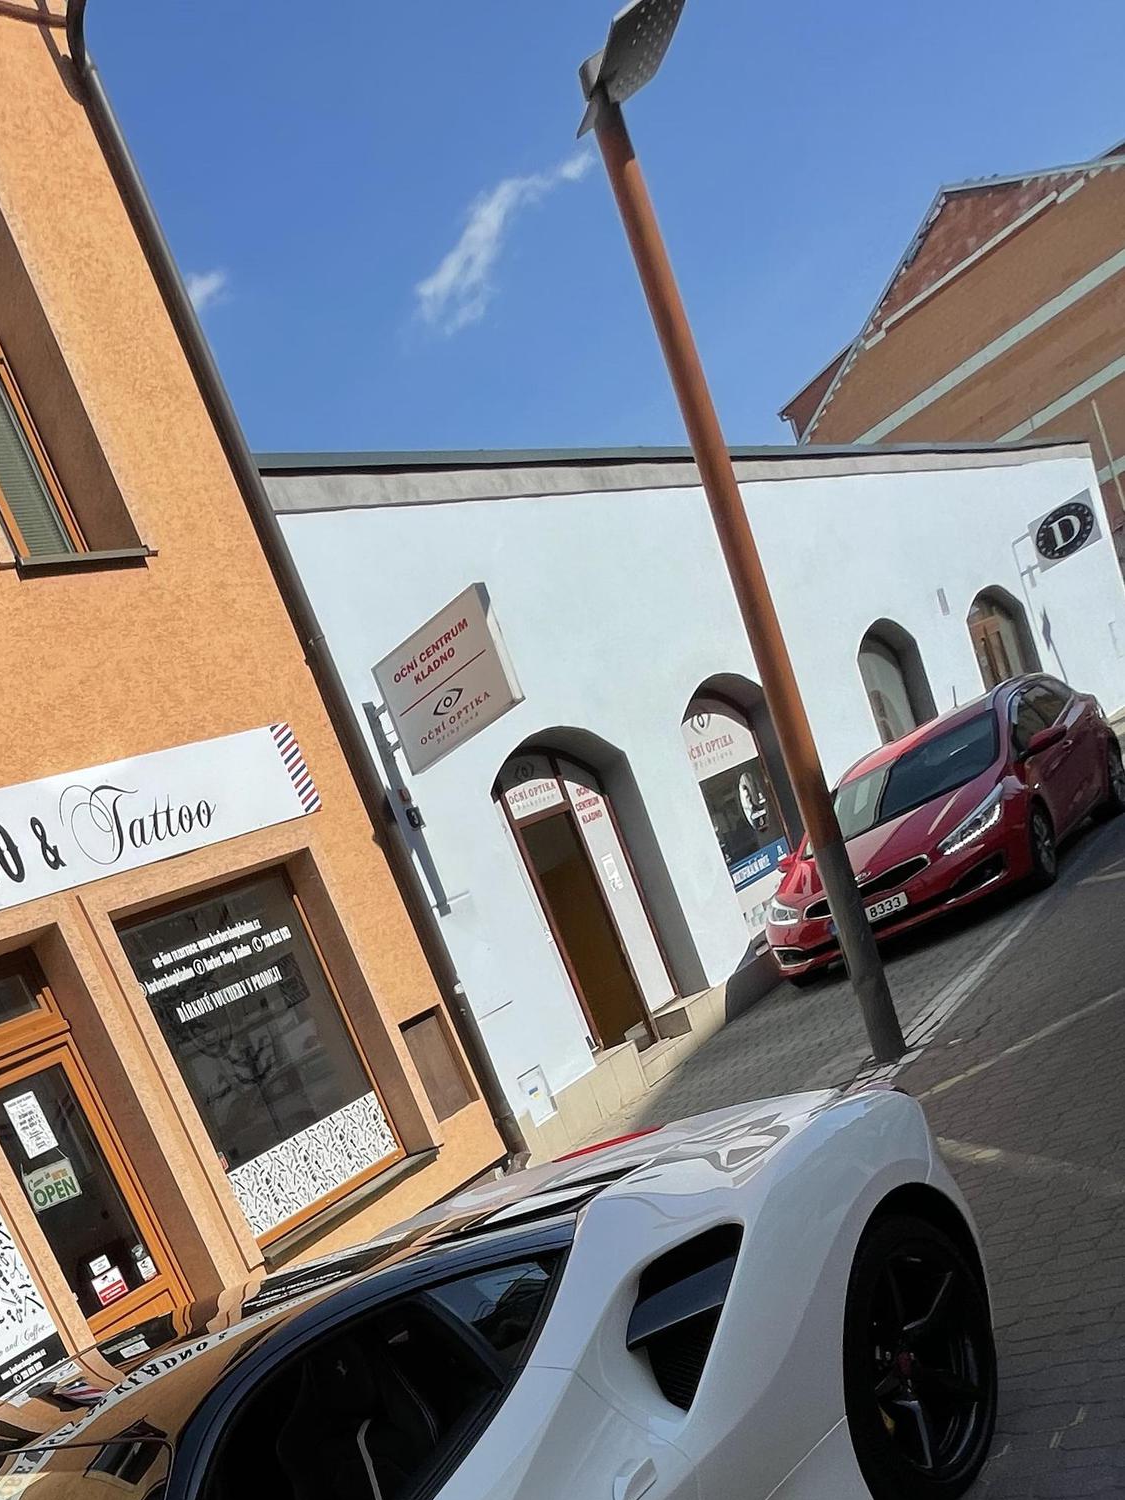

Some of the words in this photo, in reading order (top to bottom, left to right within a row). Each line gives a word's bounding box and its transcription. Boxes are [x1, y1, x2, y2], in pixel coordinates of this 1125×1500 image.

[393, 656, 418, 683] OČNÍ
[419, 618, 469, 663] CENTRUM
[414, 647, 455, 685] KLADNO
[420, 721, 446, 745] OČNÍ
[449, 691, 491, 725] OPTIKA
[705, 734, 733, 753] OPTIKA
[529, 781, 556, 797] OPTIKA
[30, 816, 67, 871] &
[59, 784, 216, 865] Tattoo
[869, 896, 901, 918] 8333
[249, 966, 283, 991] PRODEJI
[33, 1176, 77, 1207] OPEN
[4, 1334, 19, 1353] and
